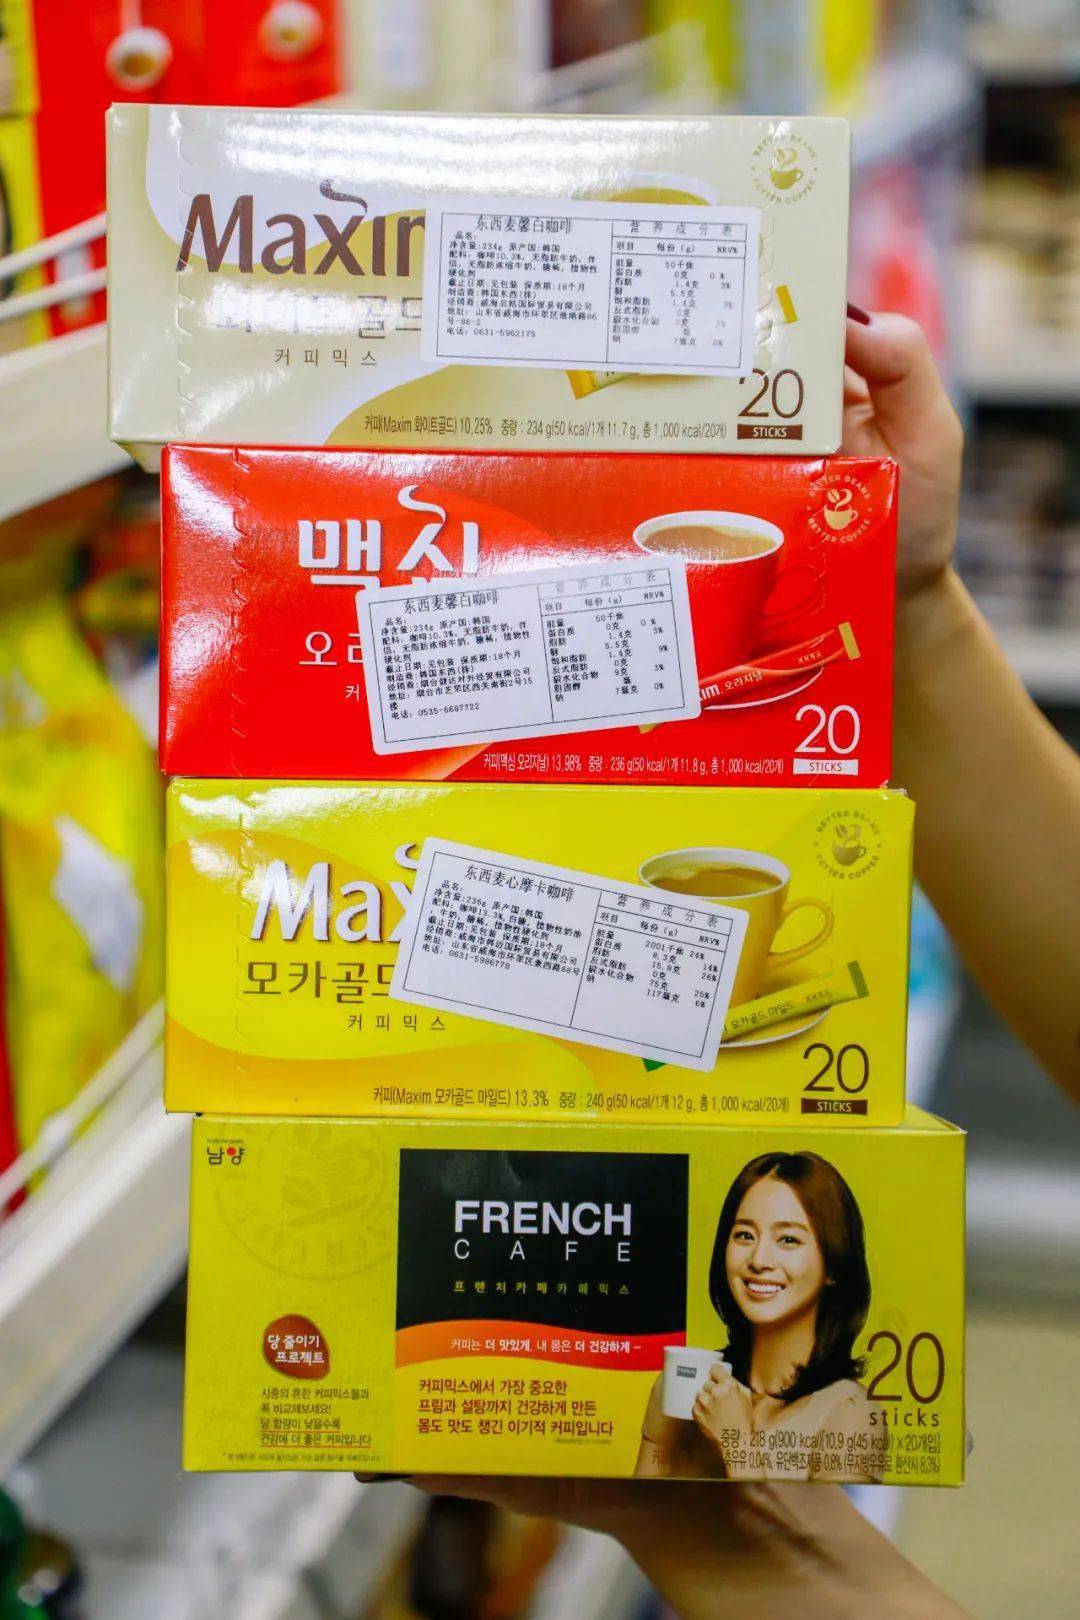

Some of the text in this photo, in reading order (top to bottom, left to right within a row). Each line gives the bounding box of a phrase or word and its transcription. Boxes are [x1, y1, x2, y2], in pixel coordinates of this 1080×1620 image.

[475, 214, 572, 234] 东西麦馨白咖啡
[274, 348, 377, 367] 커피믹스
[738, 368, 804, 419] 20
[460, 416, 493, 435] 10.25%
[527, 420, 543, 436] 234
[752, 426, 788, 438] STICKS
[404, 591, 498, 614] 东西麦馨白咖啡
[794, 704, 861, 754] 20
[610, 757, 625, 772] 236
[711, 757, 719, 774] 총
[809, 761, 843, 772] STICKS
[464, 864, 576, 903] 东西麦心摩卡咖啡
[600, 912, 619, 923] 项目
[348, 1013, 446, 1032] 커피믹스
[802, 1043, 870, 1093] 20
[435, 1087, 475, 1107] 모카골드
[515, 1089, 549, 1108] 13.3%
[559, 1090, 576, 1109] 중량
[587, 1092, 603, 1107] 240
[673, 1095, 683, 1109] 12
[817, 1101, 852, 1112] STICKS
[206, 1146, 246, 1166] 남양
[454, 1200, 632, 1236] FRENCH
[267, 1335, 320, 1350] 당 줄이기
[450, 1338, 481, 1350] 커피는
[485, 1339, 495, 1350] 더
[536, 1339, 547, 1352] 내
[551, 1340, 571, 1352] 몸은
[575, 1340, 585, 1352] 더
[588, 1340, 631, 1354] 건강하게
[275, 1351, 325, 1366] 프로젝트
[867, 1331, 945, 1404] 20
[419, 1379, 568, 1396] 커피믹스에서 가장 중요한
[418, 1399, 597, 1417] 프림과 설탕까지 건강하게 만든
[869, 1407, 940, 1427] sticks
[417, 1418, 614, 1437] 몸도 맛도 챙긴 이기적 커피입니다
[326, 1433, 371, 1445] 커피입니다
[721, 1428, 740, 1448] 중량
[750, 1430, 766, 1448] 218
